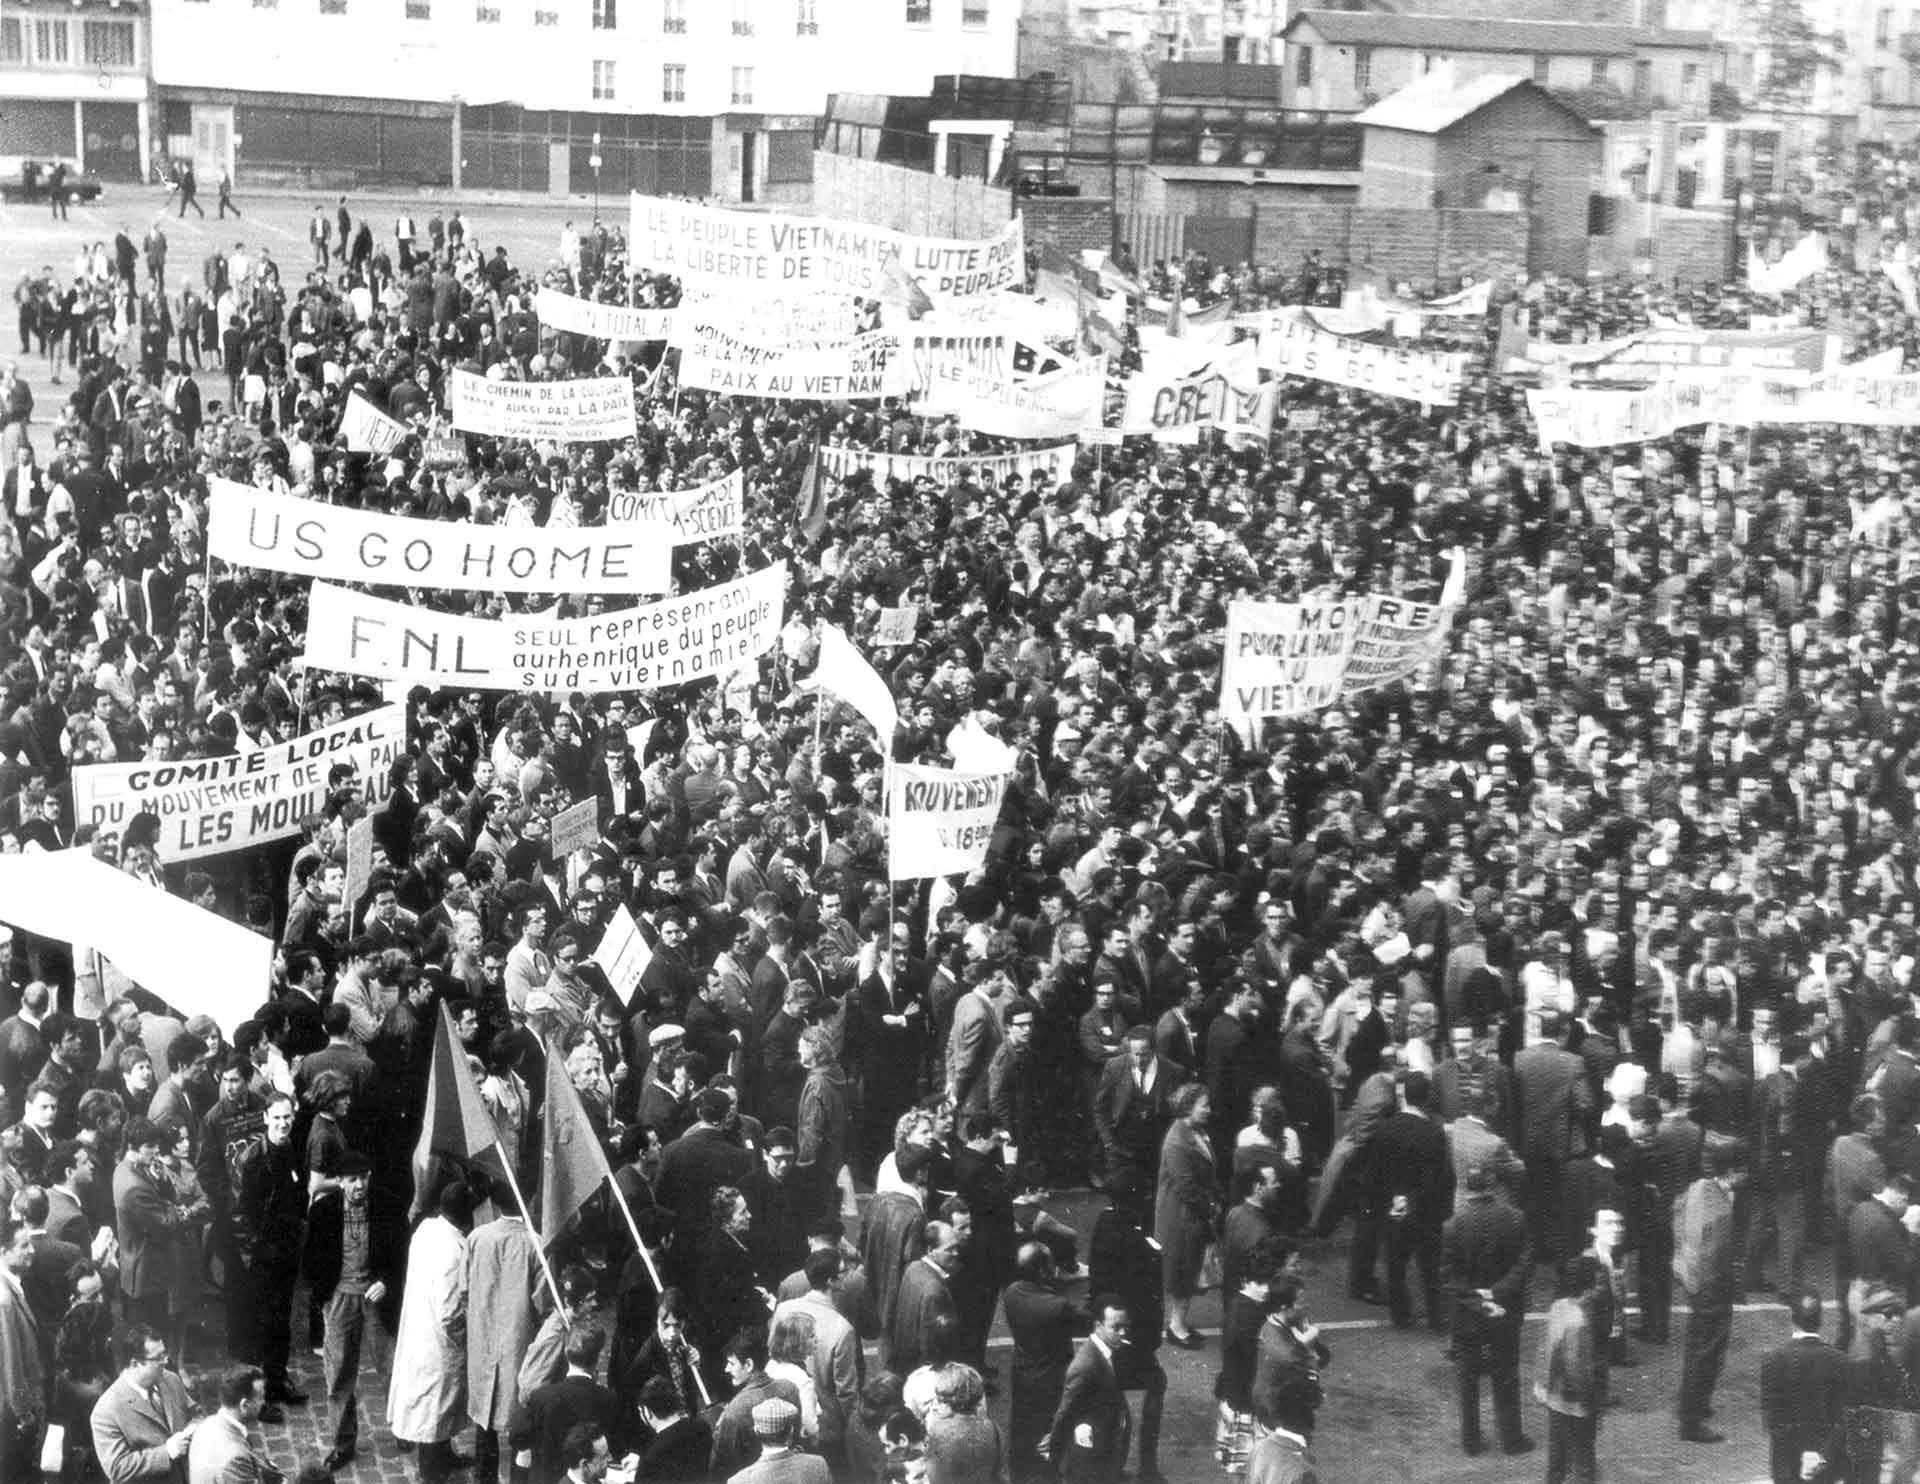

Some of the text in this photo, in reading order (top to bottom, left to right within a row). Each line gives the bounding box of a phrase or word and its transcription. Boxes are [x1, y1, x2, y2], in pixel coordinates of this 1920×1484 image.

[648, 208, 670, 233] LE
[681, 215, 759, 249] PEUPLE
[914, 245, 980, 271] LUTTE
[652, 239, 676, 264] LA
[687, 247, 768, 280] LIBERTE
[783, 256, 812, 280] DE
[822, 256, 873, 289] TOUS
[938, 260, 1016, 298] PEUPLES
[486, 383, 532, 399] CHEMIN
[539, 387, 553, 401] DE
[562, 386, 576, 400] LA
[578, 401, 598, 416] LA
[603, 395, 629, 412] PAIX
[710, 366, 759, 391] PAIX
[768, 375, 793, 393] AU
[248, 507, 634, 580] US GO HOME
[513, 600, 771, 669] authentique du peuple
[514, 628, 578, 647] SEUL
[128, 722, 385, 792] COMITE LOCAL
[92, 802, 124, 826] DU
[141, 773, 281, 818] MOUVEMENT
[292, 763, 322, 789] DE
[179, 810, 234, 851] LES
